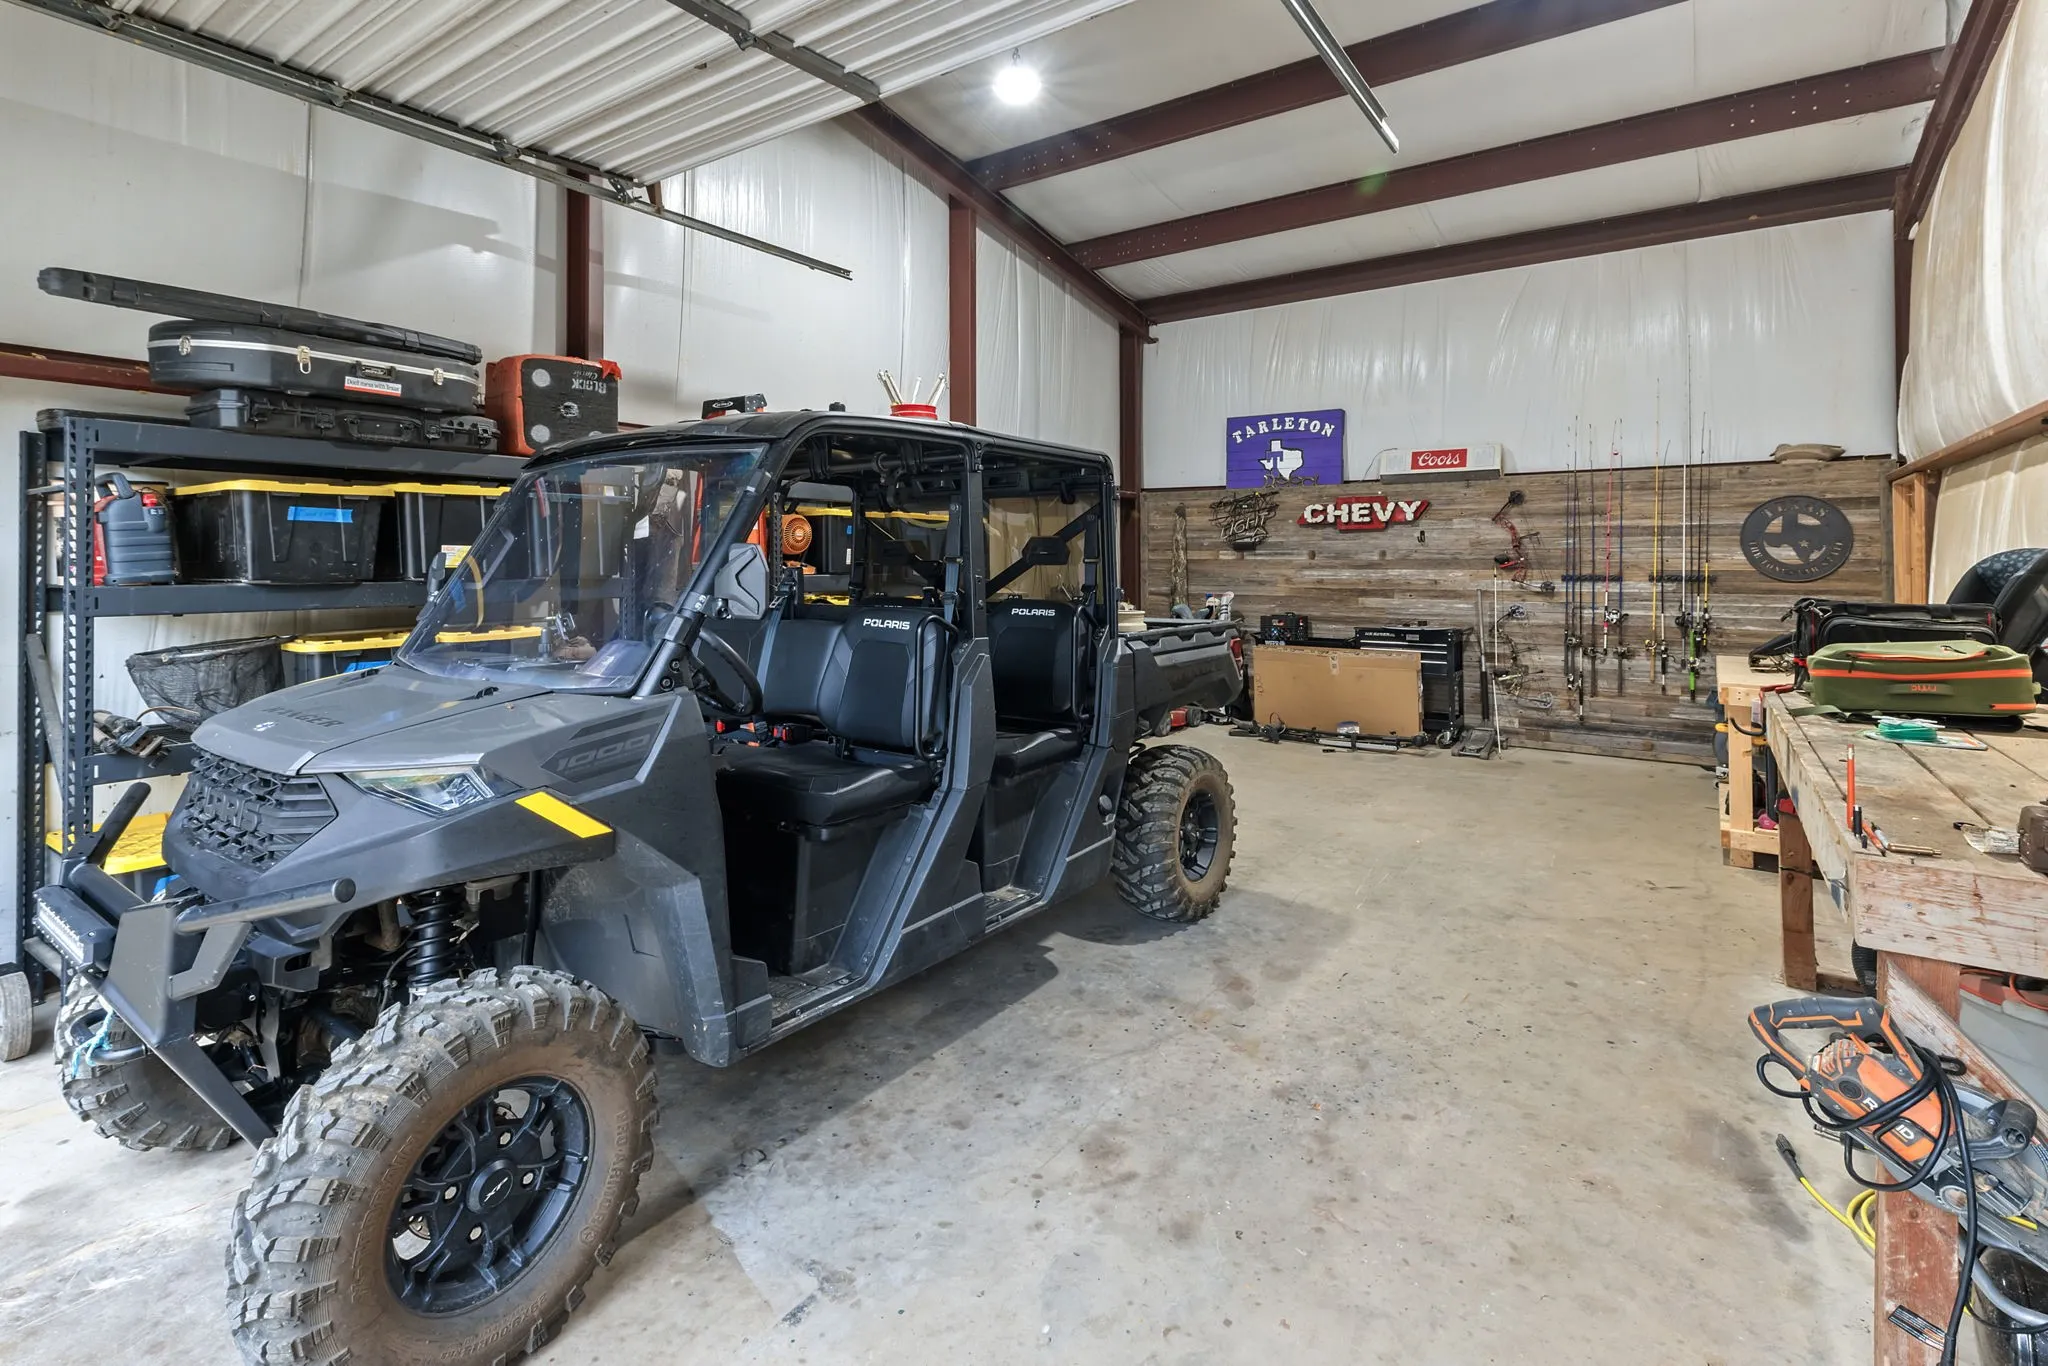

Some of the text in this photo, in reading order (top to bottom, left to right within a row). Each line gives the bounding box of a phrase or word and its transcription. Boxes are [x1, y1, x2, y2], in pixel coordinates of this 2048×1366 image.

[571, 378, 607, 394] BLOCK
[1232, 417, 1335, 444] TARLETON
[1417, 452, 1461, 467] Coors
[1303, 500, 1421, 523] CHEVY
[1221, 512, 1269, 539] LIGHT
[1011, 607, 1056, 617] POLARIS
[863, 618, 910, 630] POLARIS
[261, 706, 345, 728] RANGER
[557, 733, 651, 772] 1000
